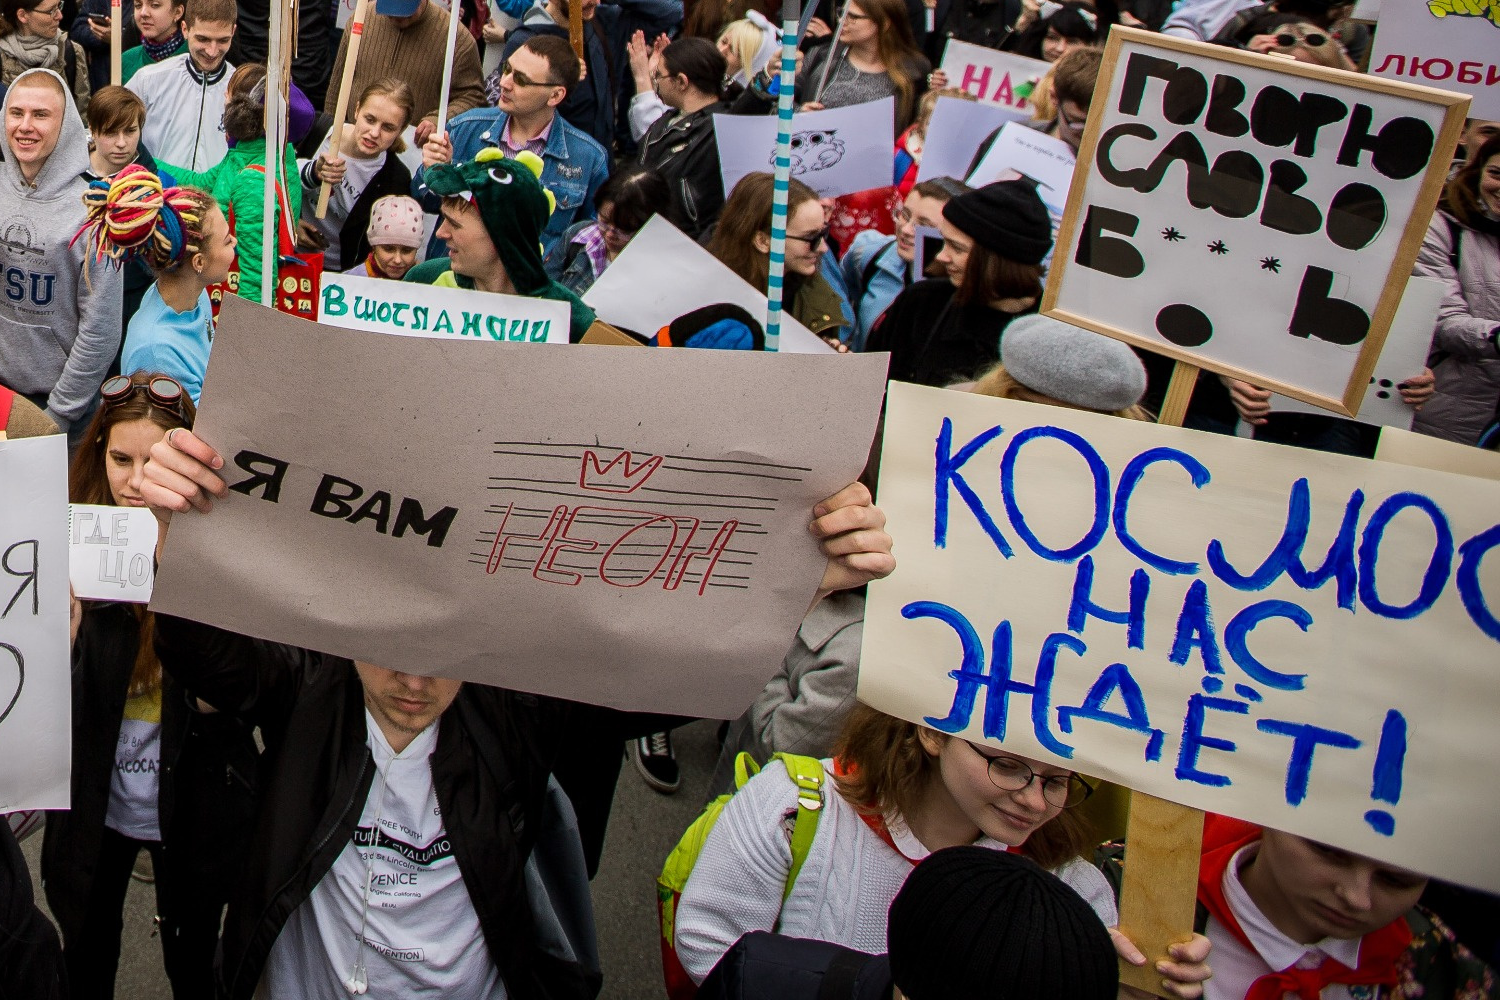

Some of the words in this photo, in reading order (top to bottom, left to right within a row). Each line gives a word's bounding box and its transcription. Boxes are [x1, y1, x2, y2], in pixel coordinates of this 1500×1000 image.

[961, 62, 1041, 110] НА
[1117, 51, 1435, 181] ГОВОРЮ
[1095, 122, 1389, 251] СЛОВО
[71, 512, 130, 547] ГДЕ
[227, 449, 289, 502] Я
[309, 473, 460, 548] ВАМ
[1068, 554, 1314, 691] НАС
[900, 600, 1408, 838] ЖДЁТ!
[387, 855, 416, 870] Lincoln
[400, 824, 423, 840] YOUTH
[371, 872, 418, 886] VENICE
